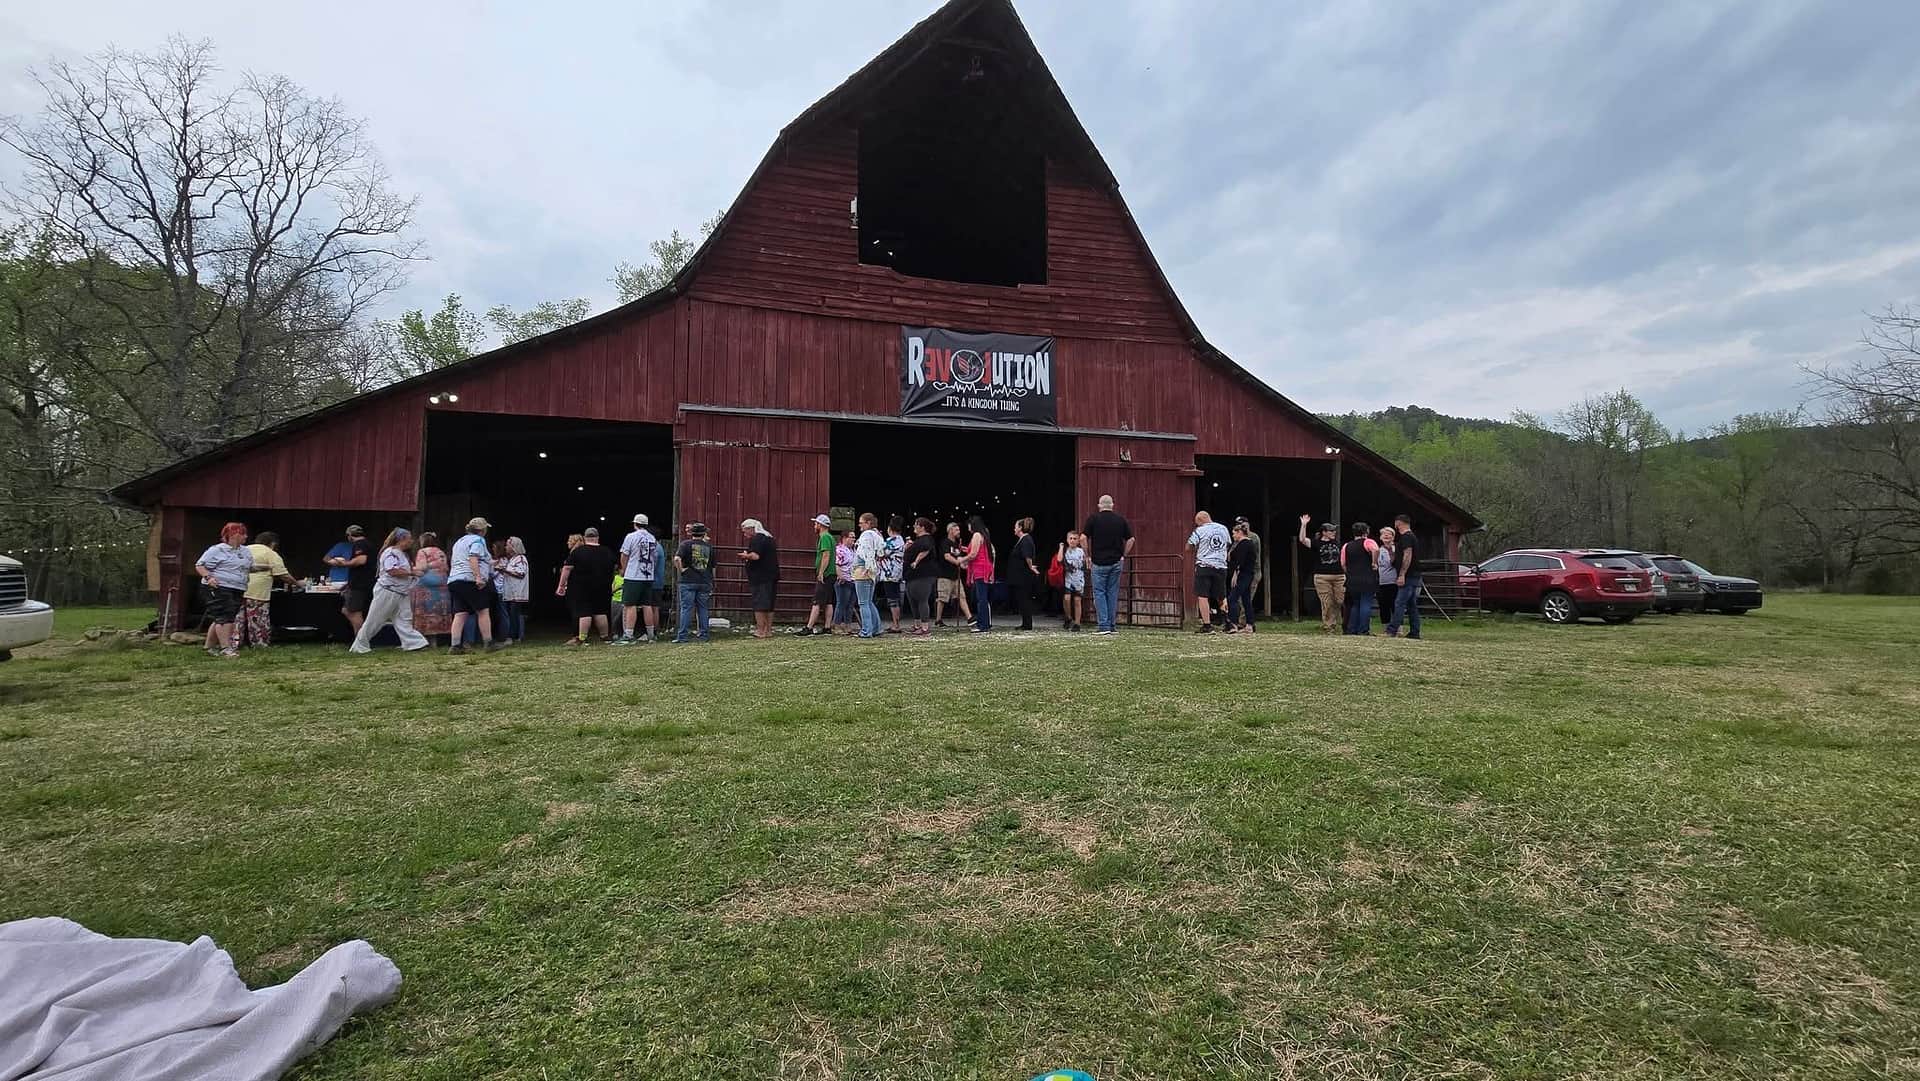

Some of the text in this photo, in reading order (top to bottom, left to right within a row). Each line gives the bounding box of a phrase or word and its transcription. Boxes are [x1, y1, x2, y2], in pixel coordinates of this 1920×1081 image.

[960, 397, 967, 408] A
[967, 398, 998, 411] KINGDOM
[1000, 400, 1020, 412] THING
